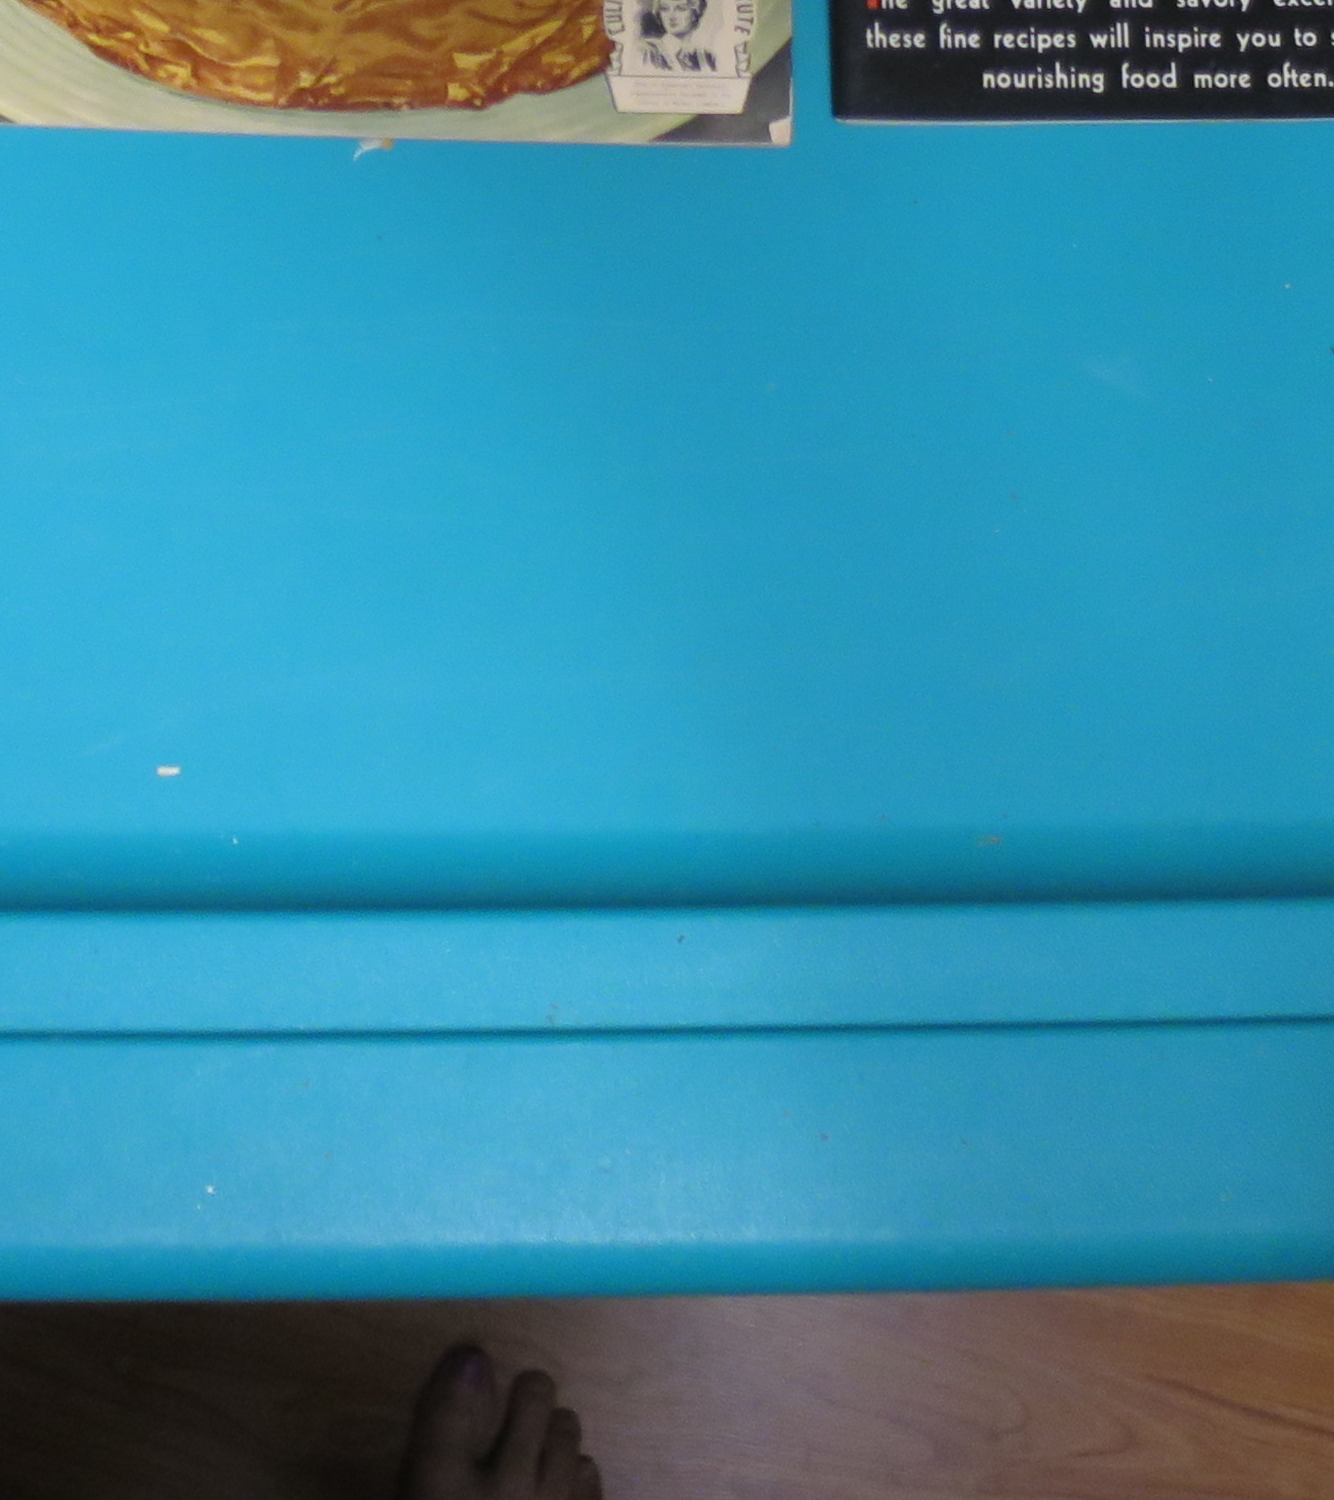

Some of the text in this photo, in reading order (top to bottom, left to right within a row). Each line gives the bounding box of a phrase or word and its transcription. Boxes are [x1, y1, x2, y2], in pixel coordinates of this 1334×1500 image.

[865, 25, 927, 51] these
[938, 23, 982, 50] fine
[993, 25, 1078, 54] recipes
[1089, 23, 1130, 49] will
[1143, 24, 1223, 54] inspire
[1235, 29, 1283, 54] you
[1293, 26, 1318, 49] to
[981, 64, 1106, 94] nourishing
[1121, 62, 1179, 90] food
[1192, 67, 1252, 89] more
